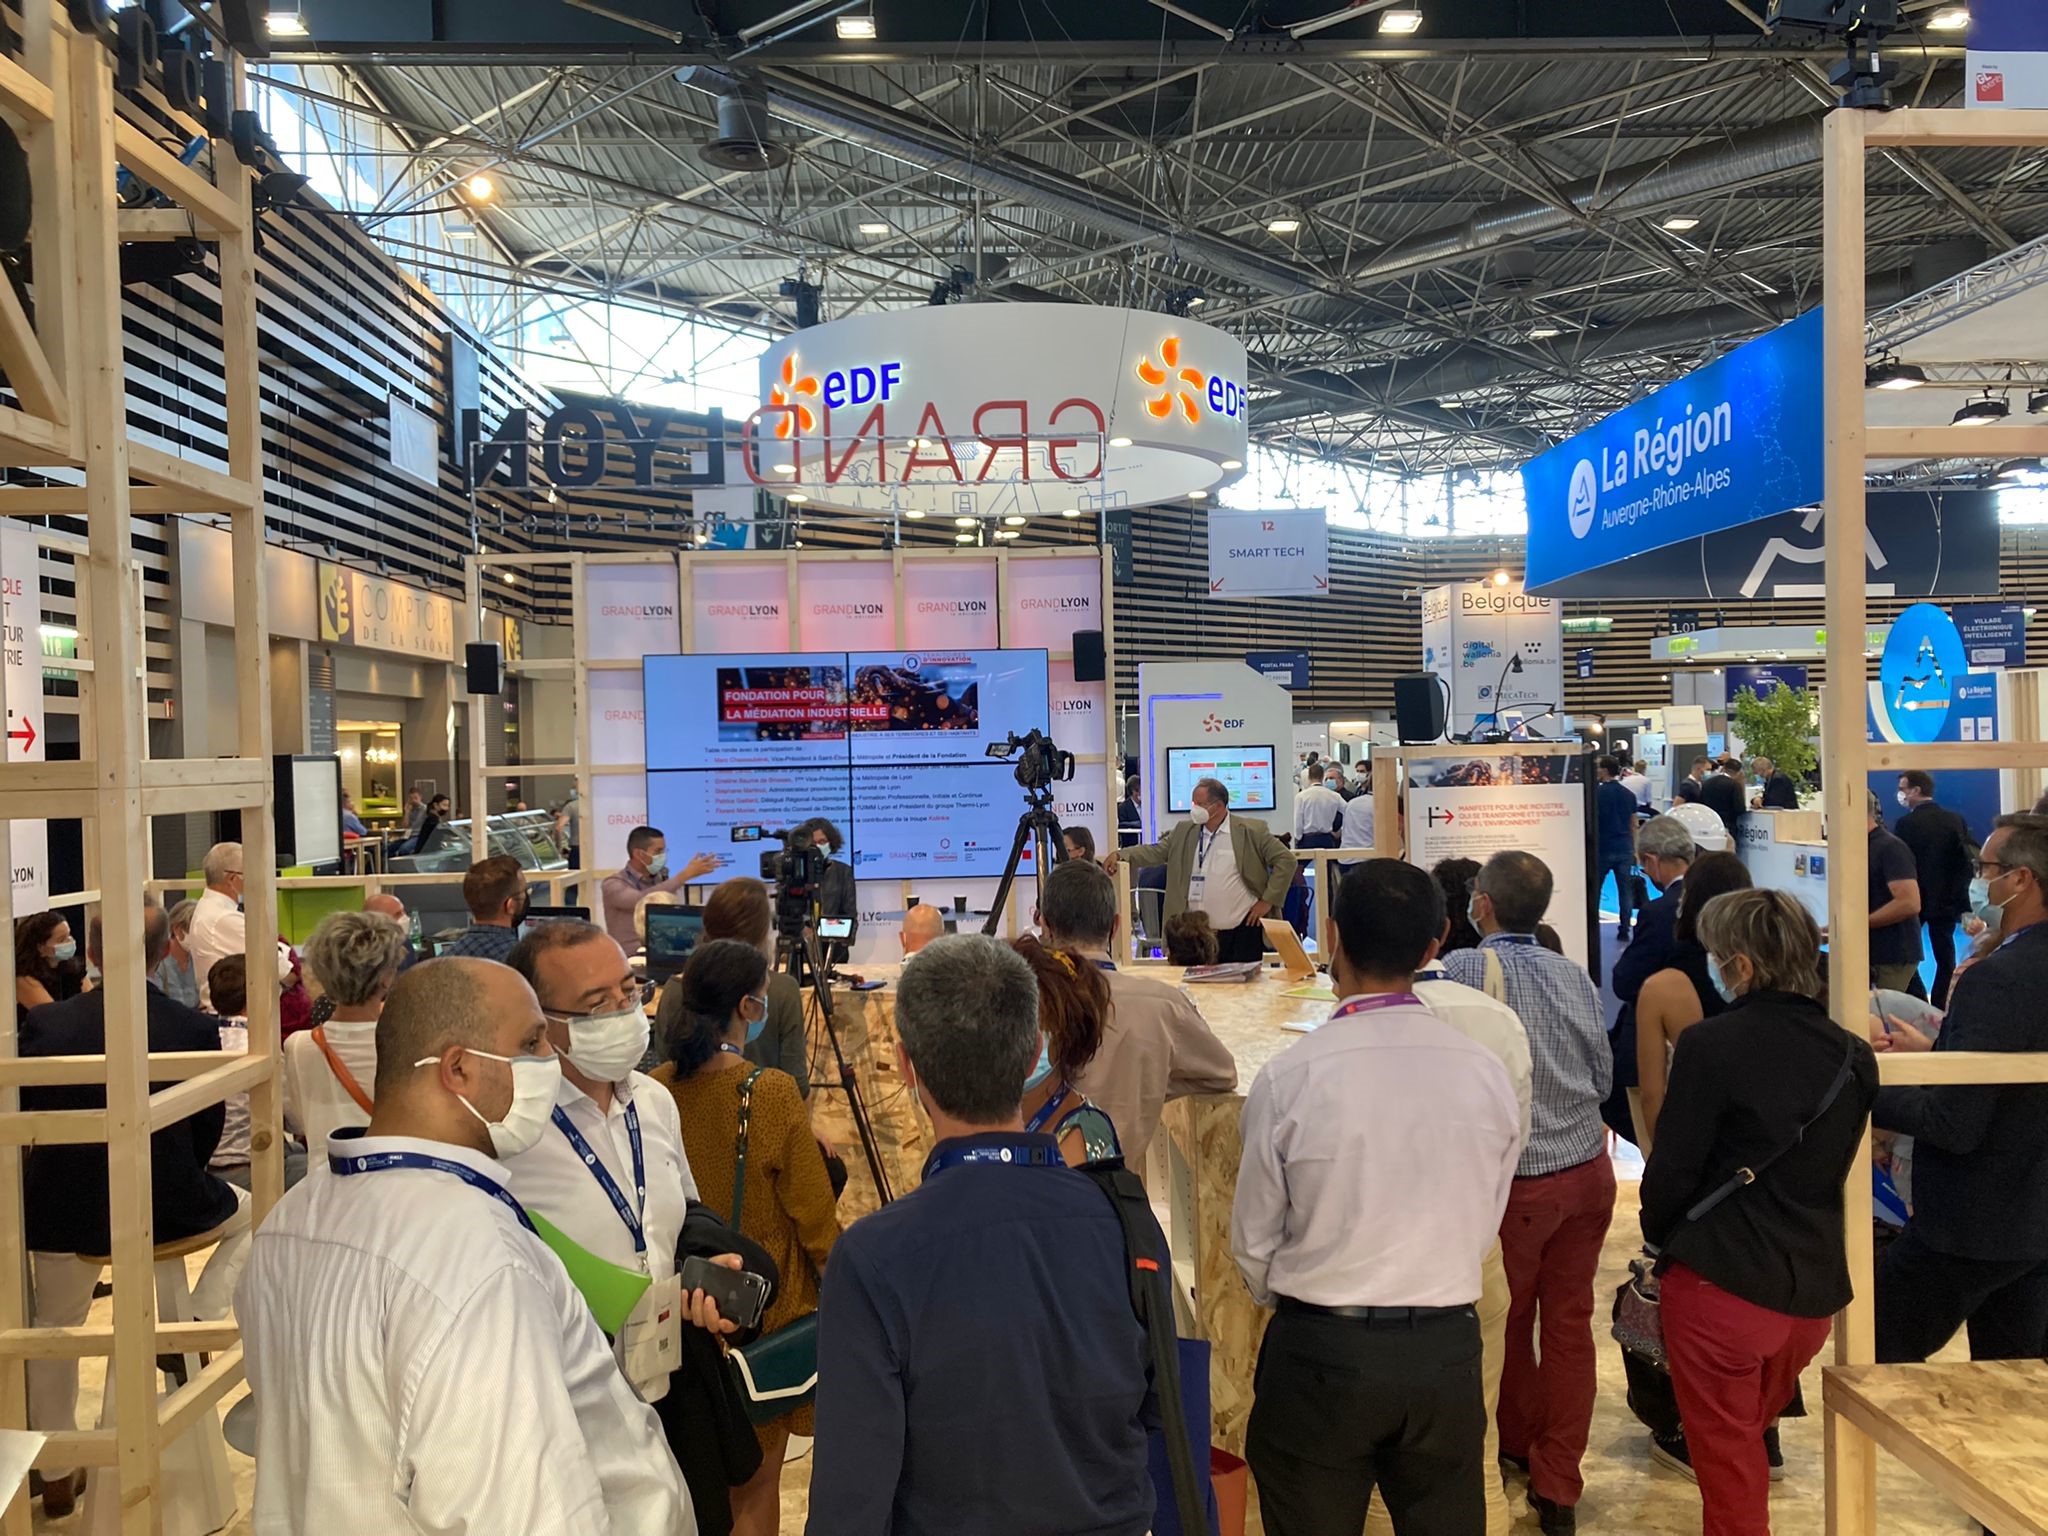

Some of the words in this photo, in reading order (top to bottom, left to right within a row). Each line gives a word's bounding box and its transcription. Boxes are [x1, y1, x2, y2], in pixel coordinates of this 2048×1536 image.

[1602, 447, 1628, 493] La
[1634, 401, 1732, 477] Région
[1601, 467, 1731, 530] Auvergne-Rhône-Alpes
[1261, 521, 1275, 531] 12
[1229, 547, 1271, 559] SMART
[1273, 547, 1305, 557] TECH
[361, 583, 450, 635] COMPTOIR
[1462, 591, 1552, 613] Belgique
[725, 690, 792, 701] FONDATION
[793, 689, 825, 700] POUR
[726, 708, 741, 719] LA
[743, 706, 805, 718] MÉDIATION
[807, 706, 887, 718] INDUSTRIELLE
